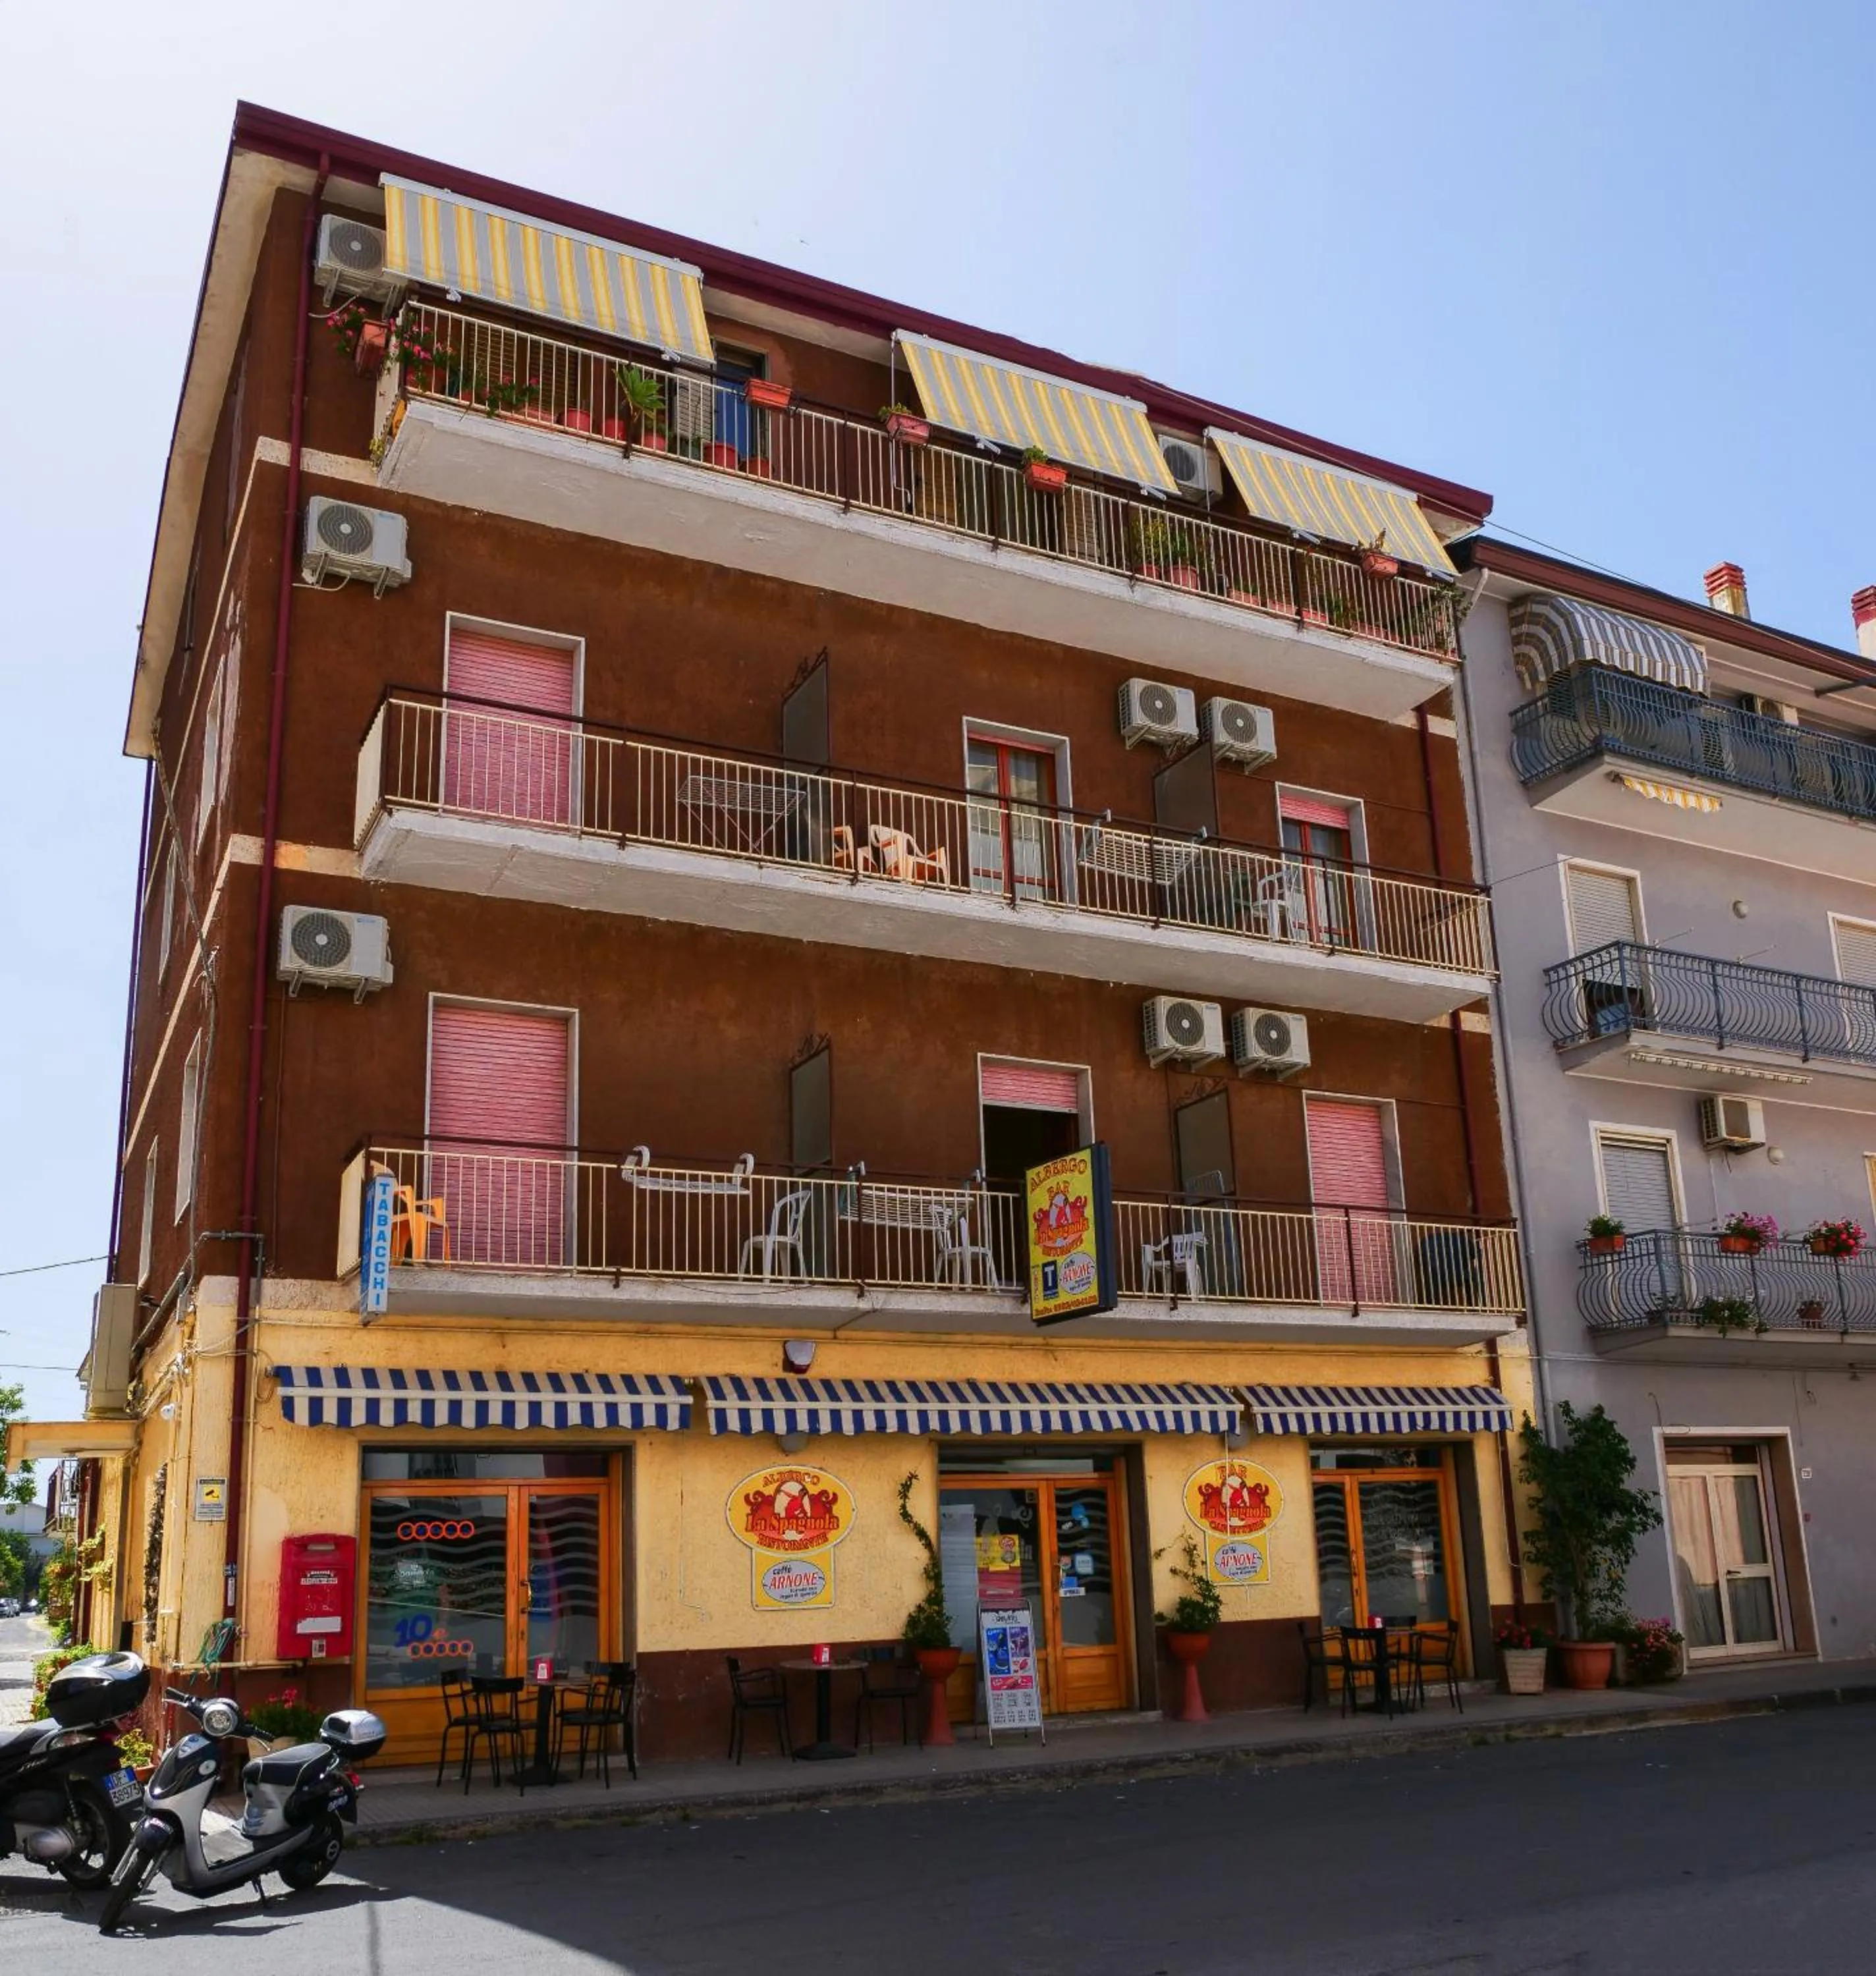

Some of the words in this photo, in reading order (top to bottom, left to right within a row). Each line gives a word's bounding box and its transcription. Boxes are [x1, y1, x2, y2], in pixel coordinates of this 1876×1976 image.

[373, 1182, 391, 1305] TABACCHI
[1045, 1265, 1055, 1286] T
[745, 1514, 767, 1533] La
[769, 1512, 840, 1535] Spagnola
[769, 1572, 819, 1589] ARNONE
[394, 1614, 433, 1648] 10
